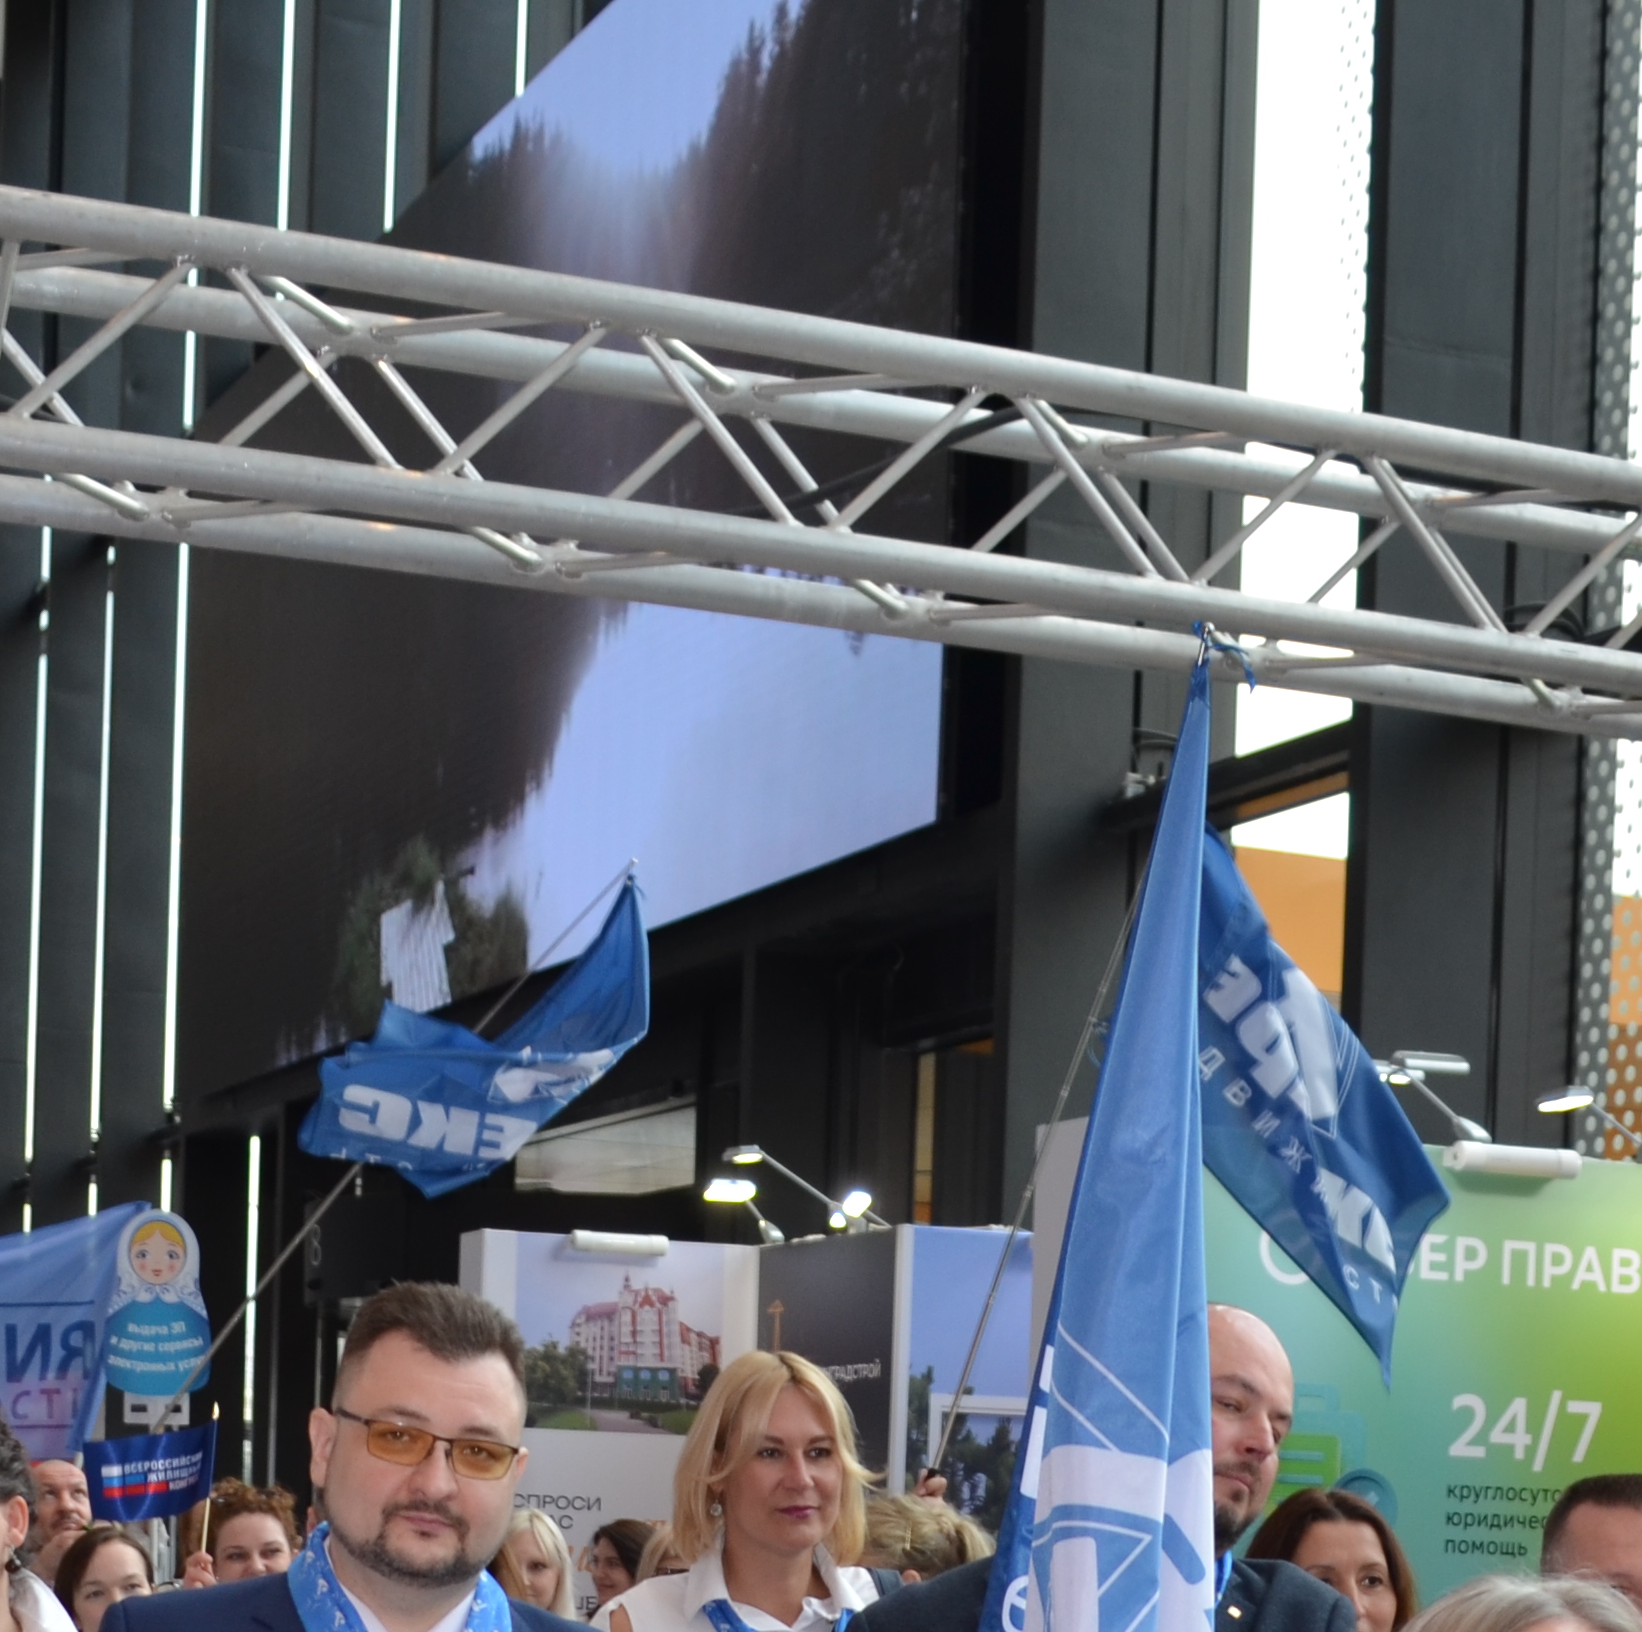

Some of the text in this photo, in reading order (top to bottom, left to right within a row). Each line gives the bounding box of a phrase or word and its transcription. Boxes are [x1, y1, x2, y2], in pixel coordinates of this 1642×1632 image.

[1260, 1226, 1489, 1283] СЕР
[1448, 1390, 1603, 1473] 24/7
[514, 1493, 602, 1512] СПРОСИ
[1445, 1538, 1528, 1559] помощь
